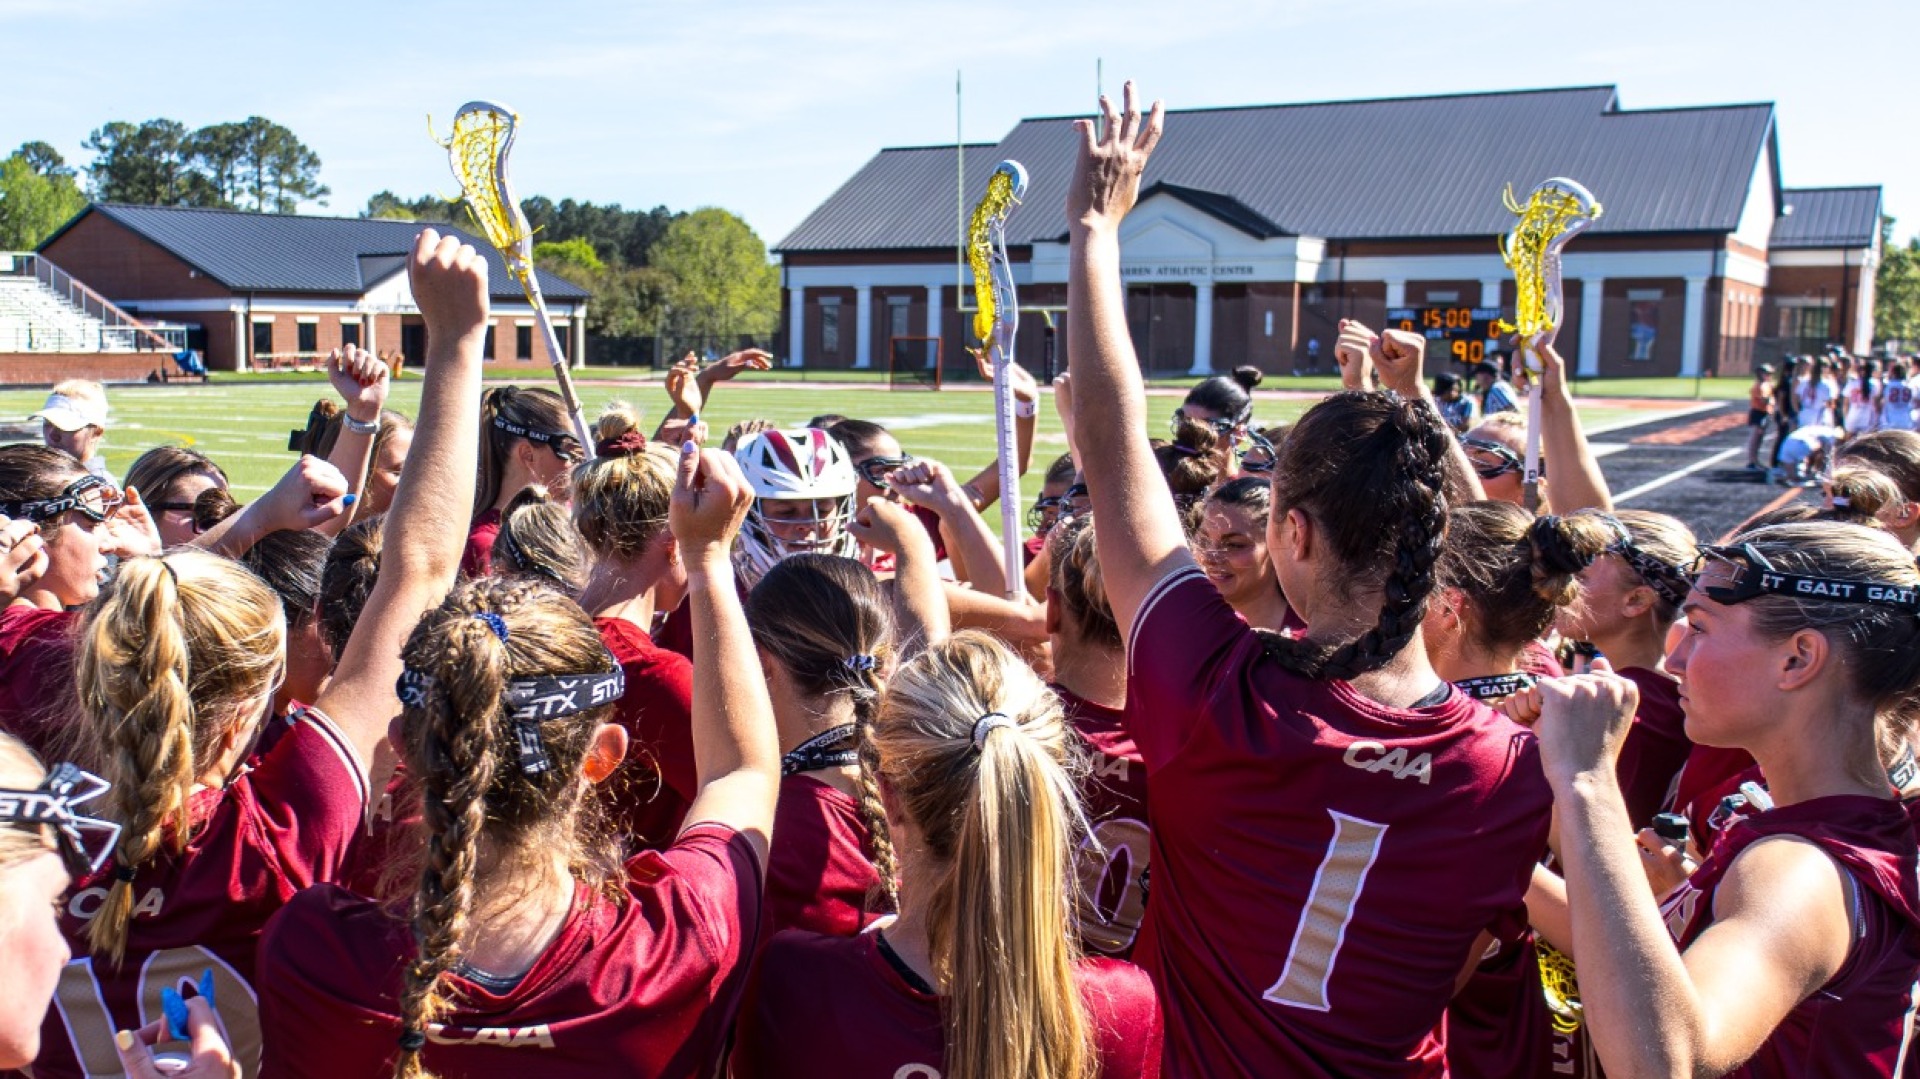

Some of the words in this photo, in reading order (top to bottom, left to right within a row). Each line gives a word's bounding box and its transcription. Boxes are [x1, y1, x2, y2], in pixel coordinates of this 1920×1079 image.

[1156, 265, 1208, 276] ATHLETIC
[1212, 265, 1254, 275] CENTER
[1488, 319, 1500, 338] 0
[1452, 340, 1484, 363] 90
[1761, 573, 1785, 588] IT
[1797, 579, 1855, 598] GAIT
[1868, 587, 1917, 604] GAIT
[511, 690, 578, 719] STX
[591, 676, 618, 704] STX
[1480, 682, 1518, 697] GAIT
[1343, 741, 1433, 785] CAA
[0, 791, 71, 819] STX
[68, 886, 165, 919] CA
[1262, 807, 1390, 1012] 1
[425, 1022, 556, 1048] CAA
